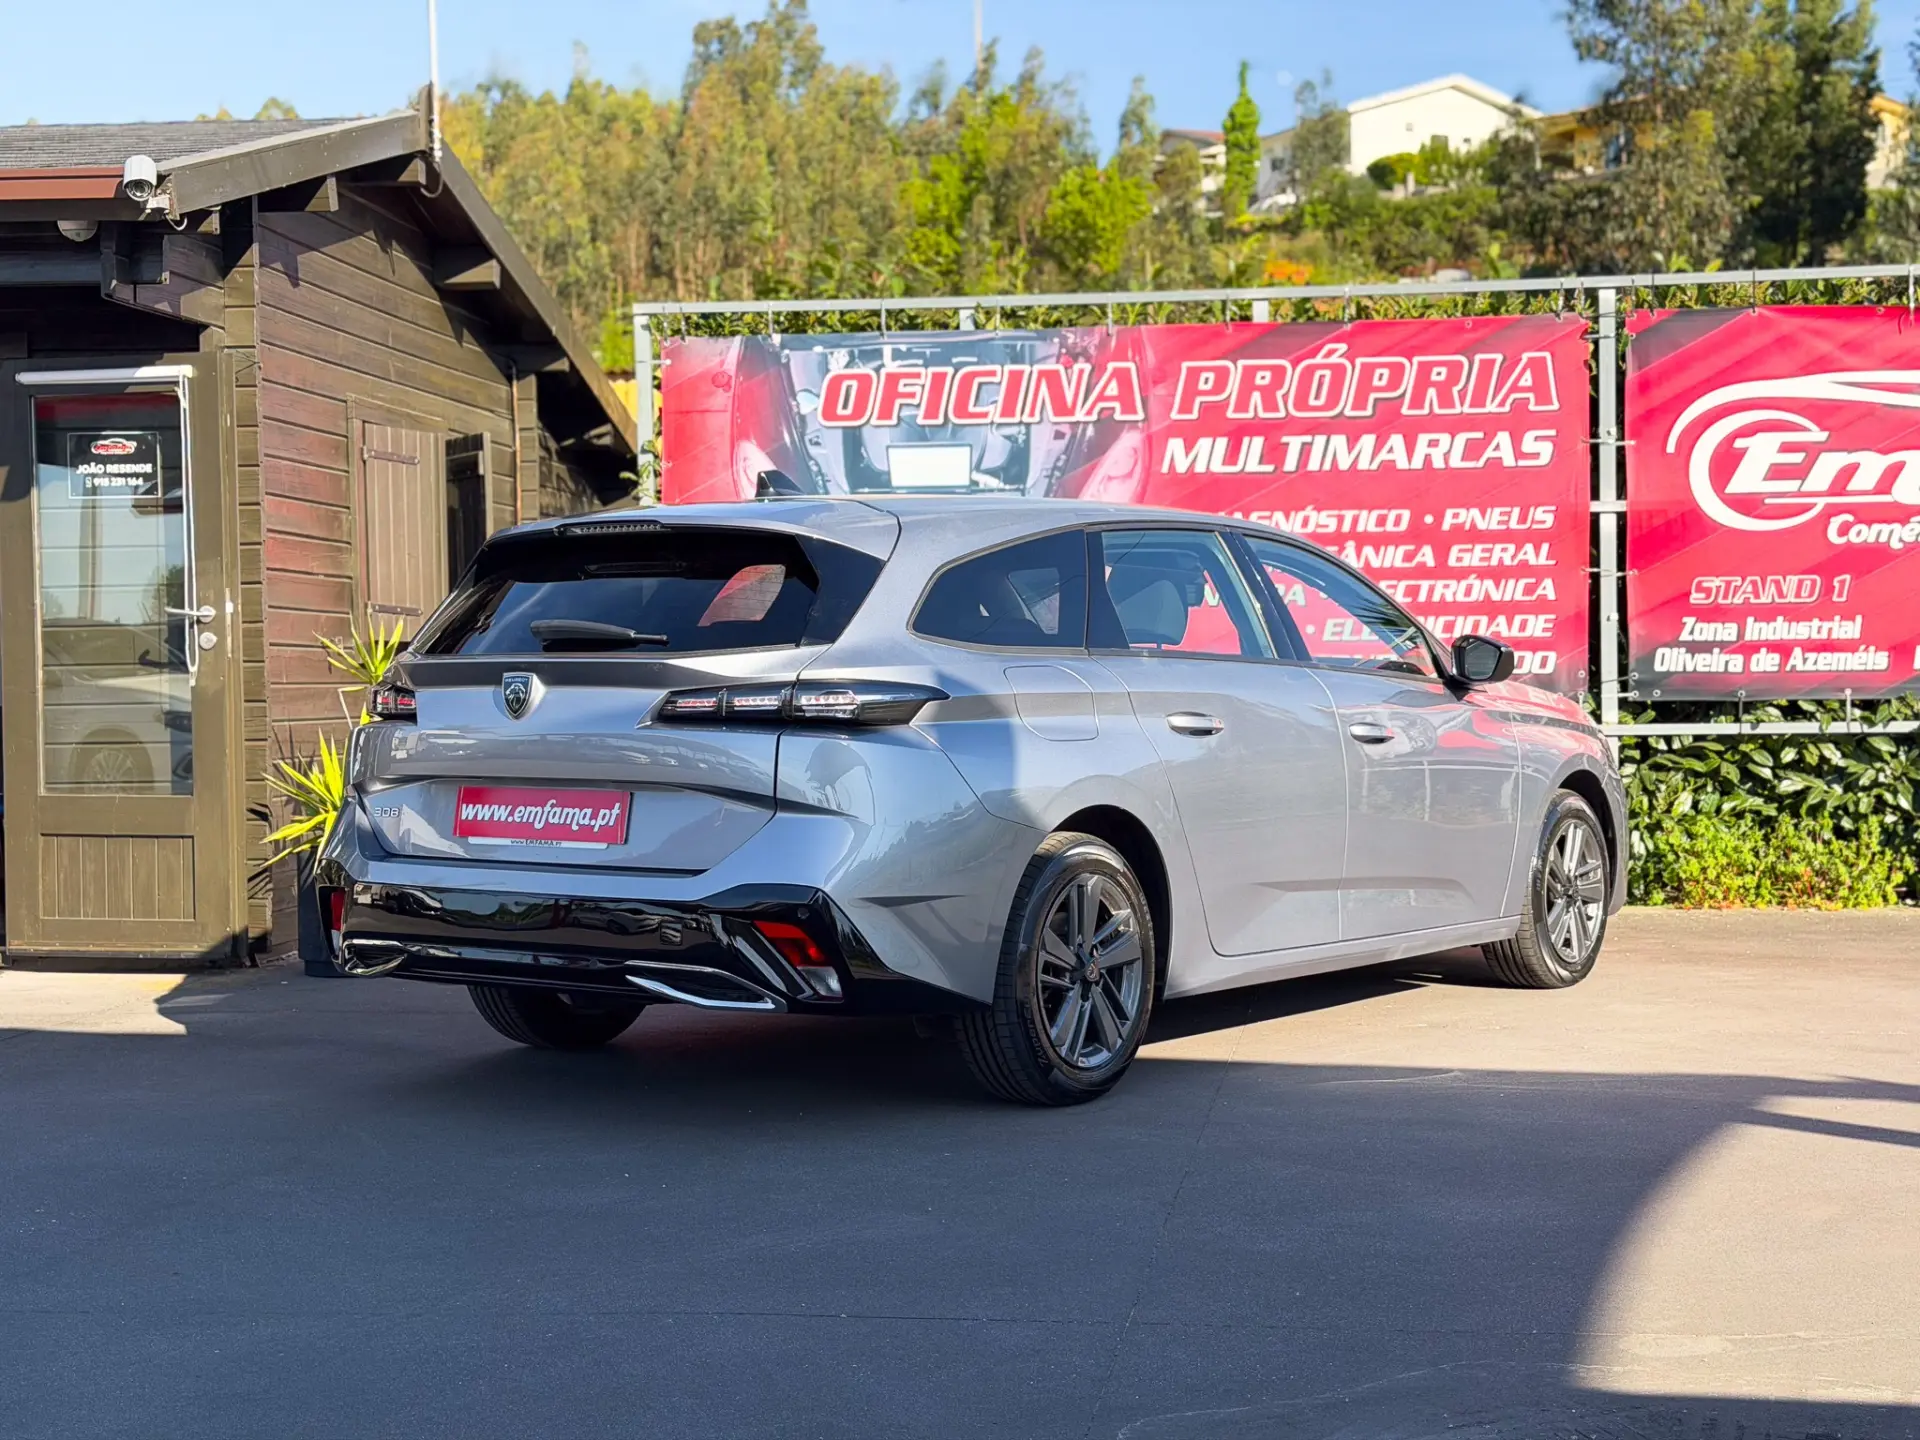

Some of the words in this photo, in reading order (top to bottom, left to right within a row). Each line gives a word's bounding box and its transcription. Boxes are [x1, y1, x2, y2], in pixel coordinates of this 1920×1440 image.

[817, 361, 1145, 427] OFICINA
[1170, 343, 1560, 420] PRÓPRIA
[1161, 429, 1556, 474] MULTIMARCAS
[76, 462, 105, 474] JOÃO
[106, 463, 153, 473] RESENDE
[1441, 505, 1557, 531] PNEUS
[1827, 513, 1920, 549] Comé
[1325, 540, 1436, 568] ÂNICA
[1447, 542, 1557, 567] GERAL
[1378, 574, 1557, 603] ECTRÓNICA
[1689, 575, 1821, 605] STAND
[1832, 575, 1851, 603] 1
[1679, 616, 1738, 642] Zona
[1745, 614, 1862, 641] Industrial
[1653, 647, 1744, 673] Oliveira
[1750, 648, 1780, 672] de
[1786, 643, 1889, 672] Azeméis
[374, 807, 400, 818] 308
[461, 799, 620, 832] www.emfama.pt
